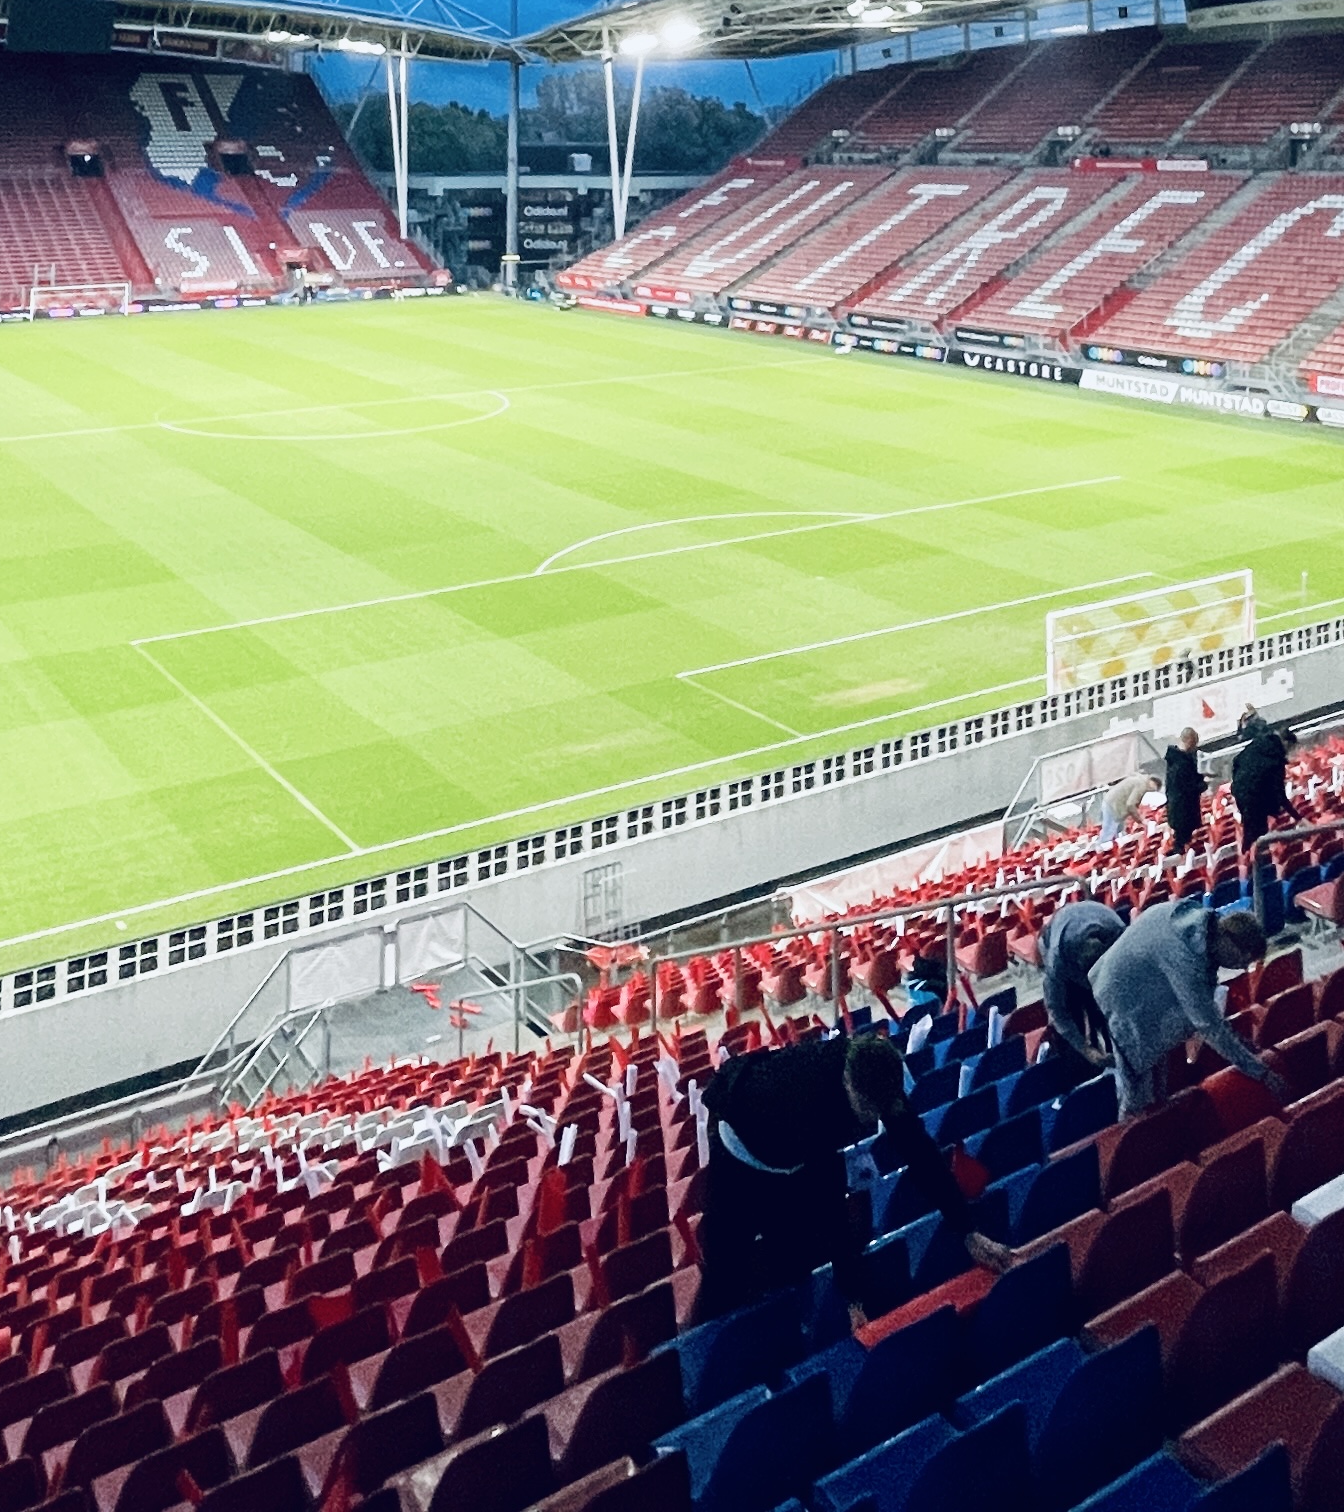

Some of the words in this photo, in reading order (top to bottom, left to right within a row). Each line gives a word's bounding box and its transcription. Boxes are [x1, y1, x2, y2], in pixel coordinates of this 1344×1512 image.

[983, 356, 1063, 382] CASTORE
[1096, 374, 1170, 398] MUNTSTAD
[1180, 387, 1265, 414] MUNTSTAD
